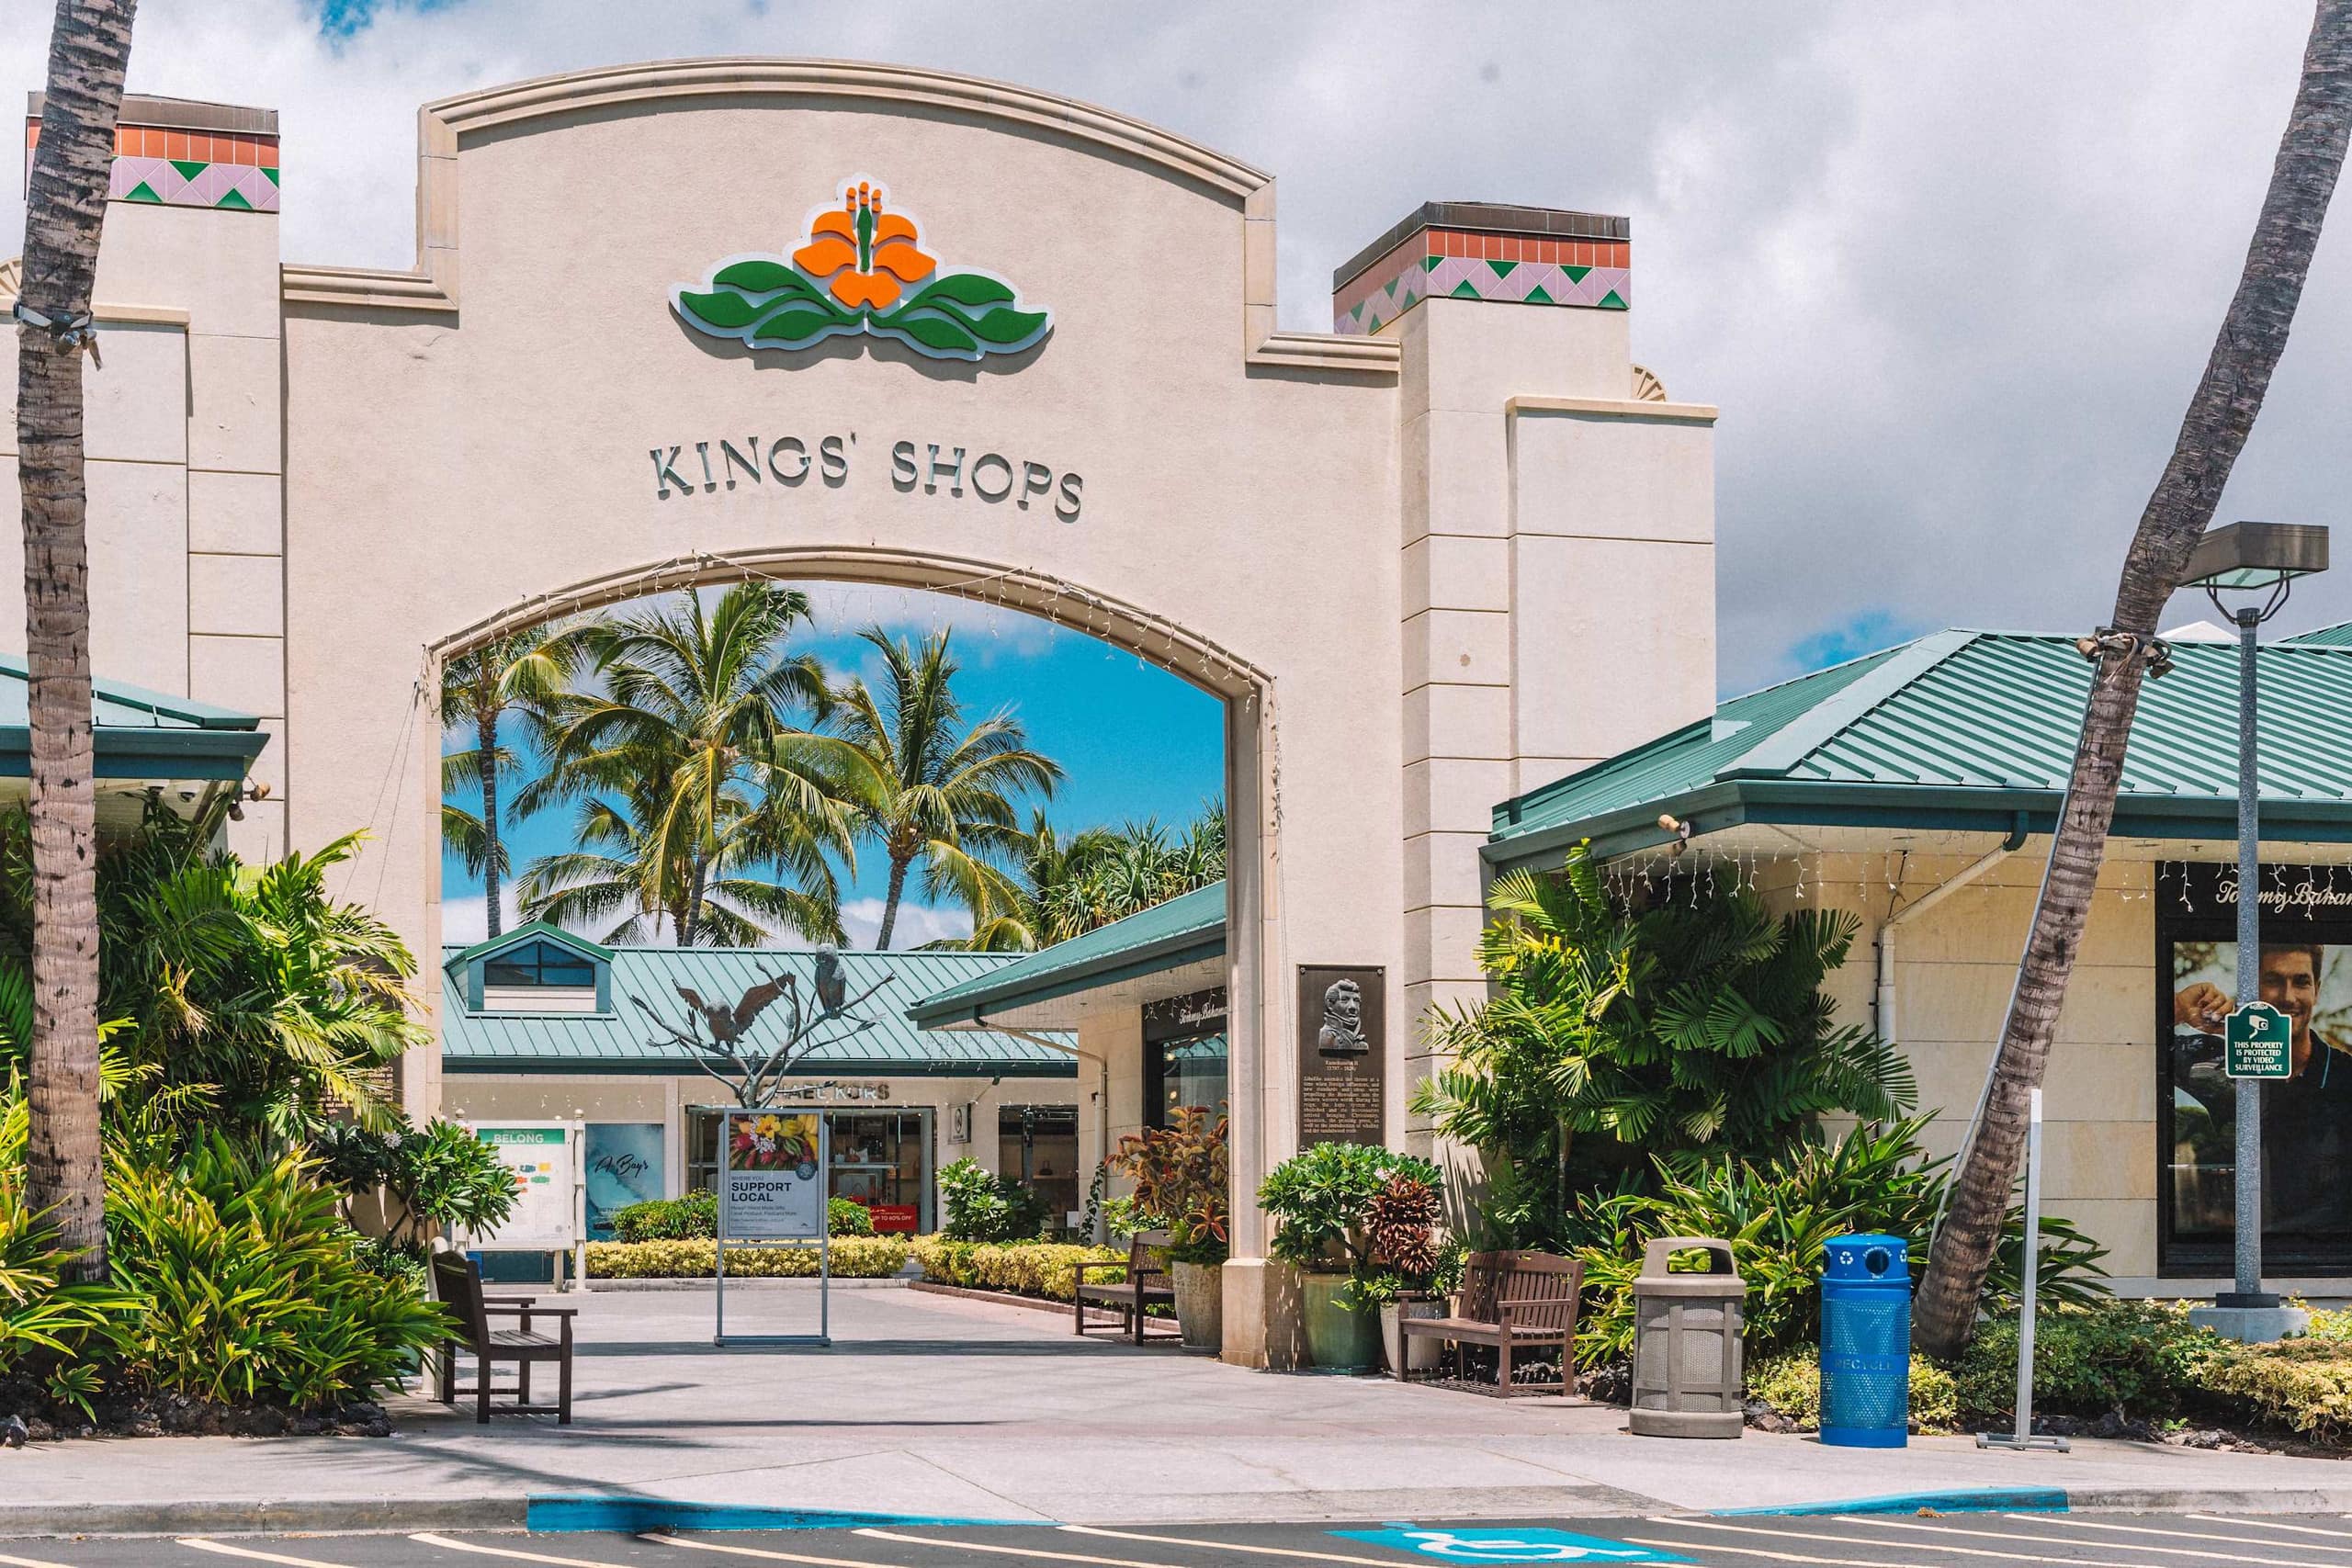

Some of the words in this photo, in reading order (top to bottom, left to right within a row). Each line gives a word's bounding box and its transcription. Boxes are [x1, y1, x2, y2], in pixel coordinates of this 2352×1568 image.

[650, 431, 856, 500] KINGS'
[890, 440, 1083, 523] SHOPS
[2215, 880, 2288, 914] Tomy
[2234, 1064, 2283, 1072] SURVEILLANCE
[834, 1081, 890, 1100] KORS
[493, 1134, 544, 1144] BELONG
[731, 1182, 792, 1191] SUPPORT
[731, 1192, 774, 1202] LOCAL
[1836, 1359, 1894, 1371] RECYCLE
